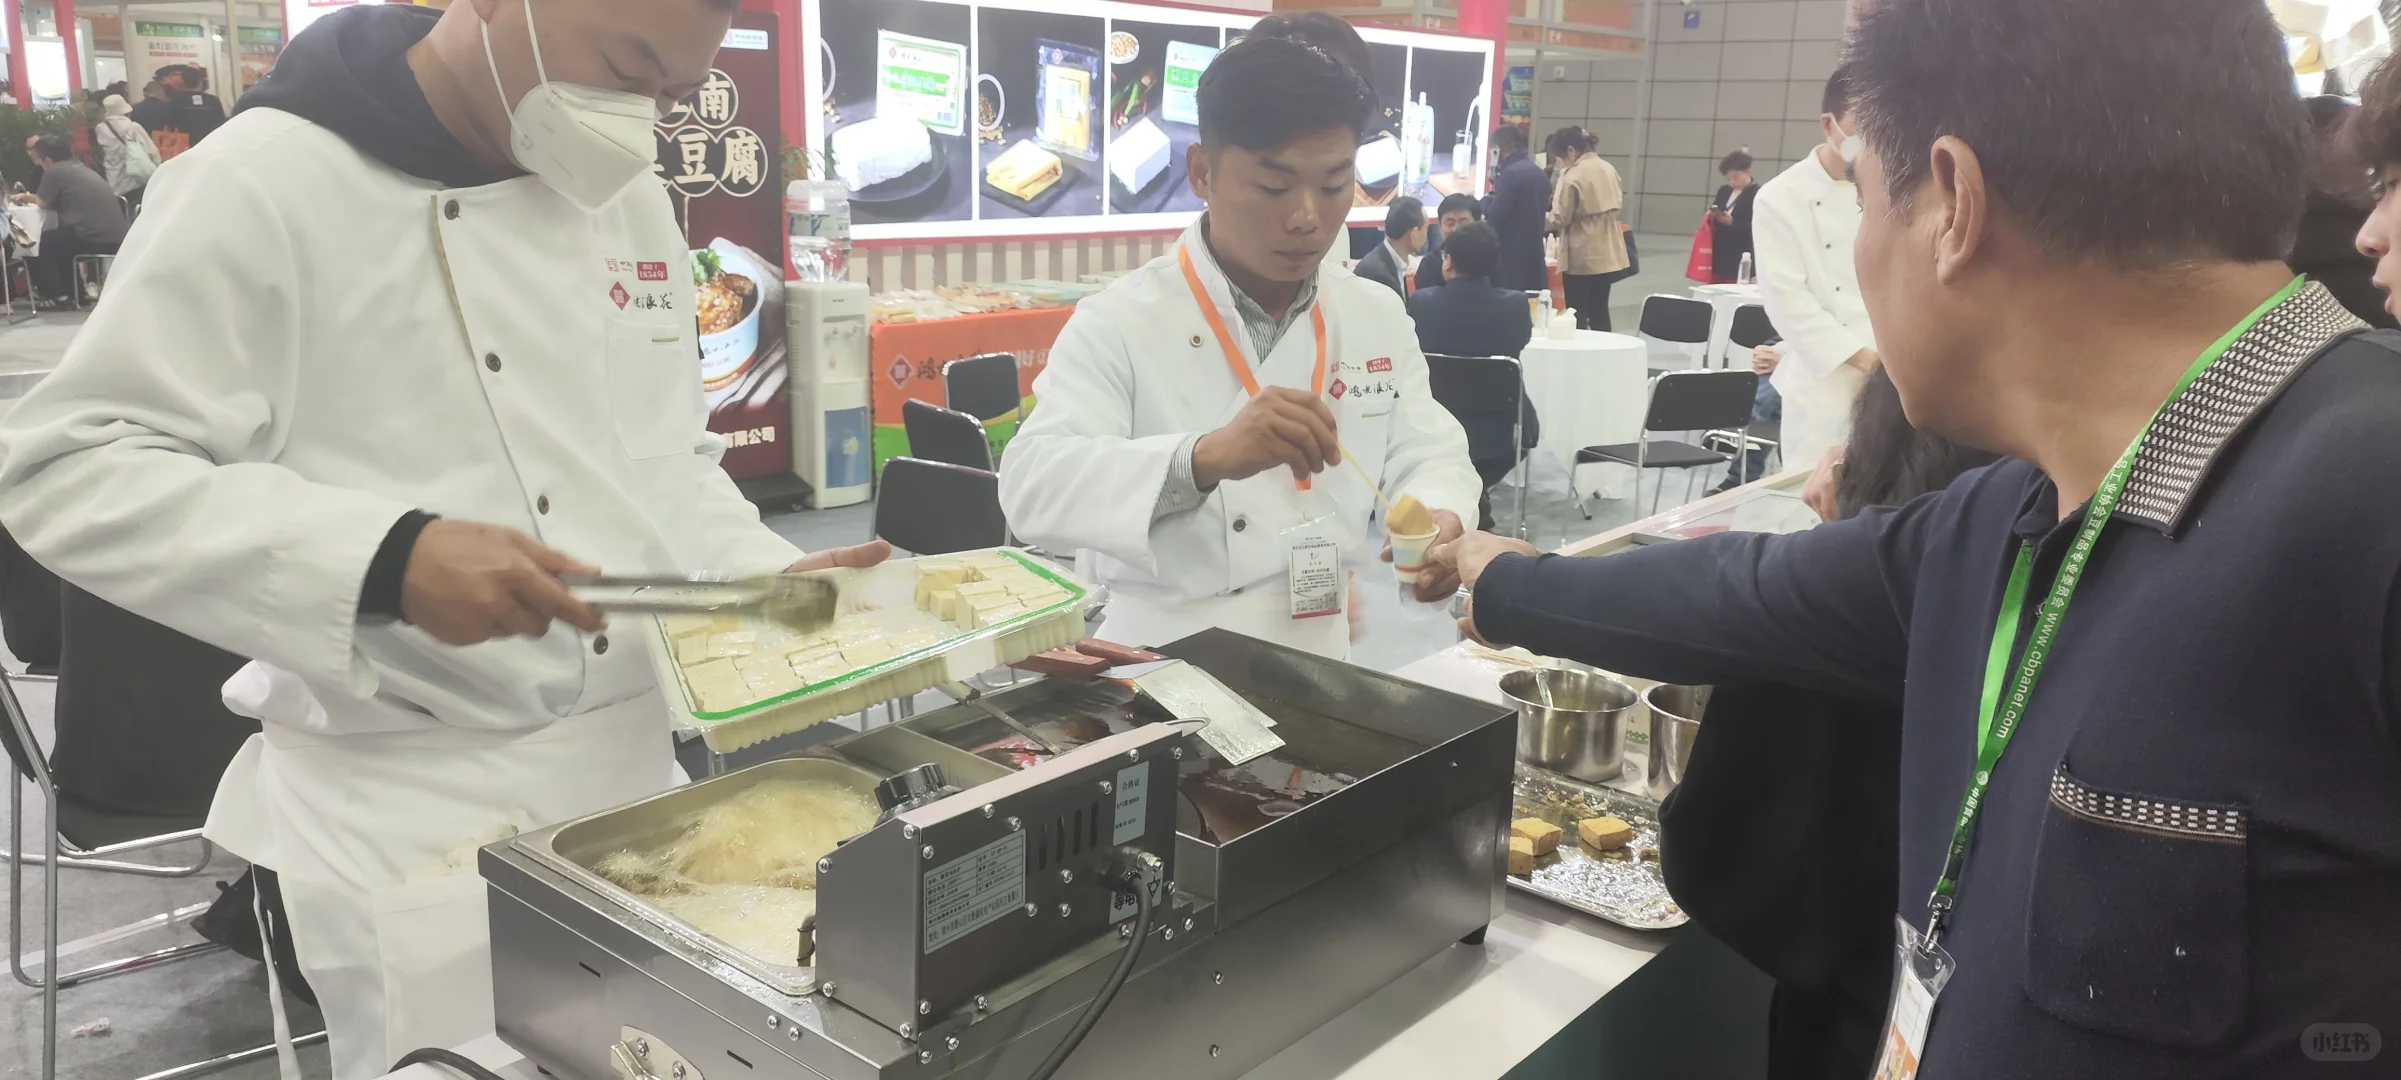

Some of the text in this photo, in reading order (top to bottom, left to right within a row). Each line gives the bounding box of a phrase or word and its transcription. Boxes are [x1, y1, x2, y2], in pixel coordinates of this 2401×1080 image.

[653, 130, 760, 186] 豆腐
[1996, 612, 2059, 740] www.cbpanet.com
[1122, 777, 1141, 792] 合格证
